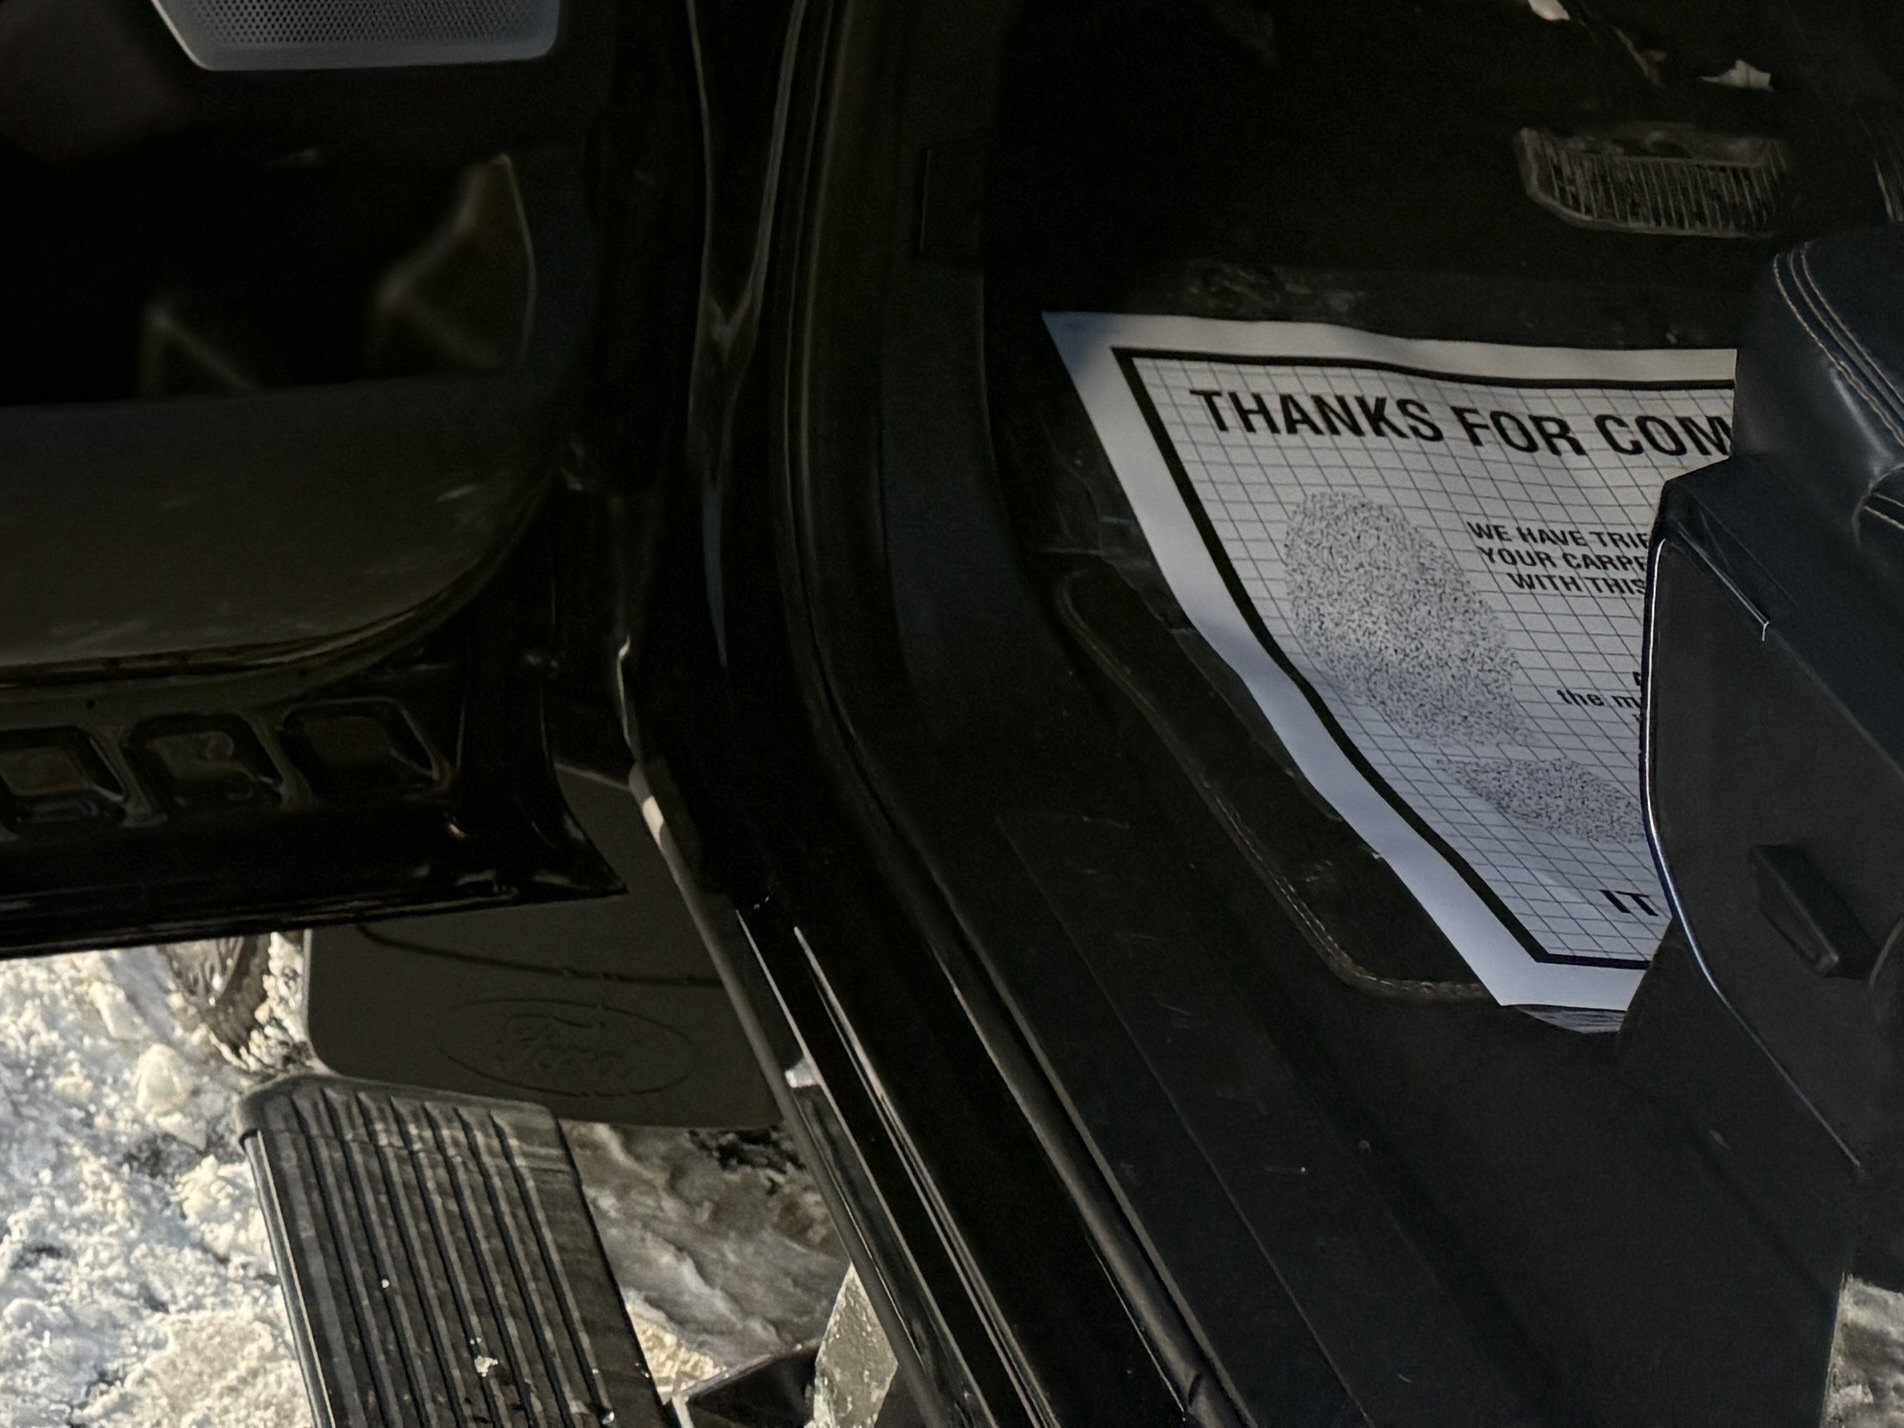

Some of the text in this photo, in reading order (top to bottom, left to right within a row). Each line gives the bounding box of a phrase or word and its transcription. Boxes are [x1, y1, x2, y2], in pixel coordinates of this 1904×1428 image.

[1189, 388, 1444, 442] THANKS
[1451, 406, 1587, 456] FOR
[1467, 521, 1512, 542] WE
[1516, 526, 1589, 547] HAVE
[1476, 545, 1558, 568] YOUR
[1506, 572, 1646, 595] WITH THIS
[1556, 689, 1604, 707] the
[1599, 889, 1659, 917] IT
